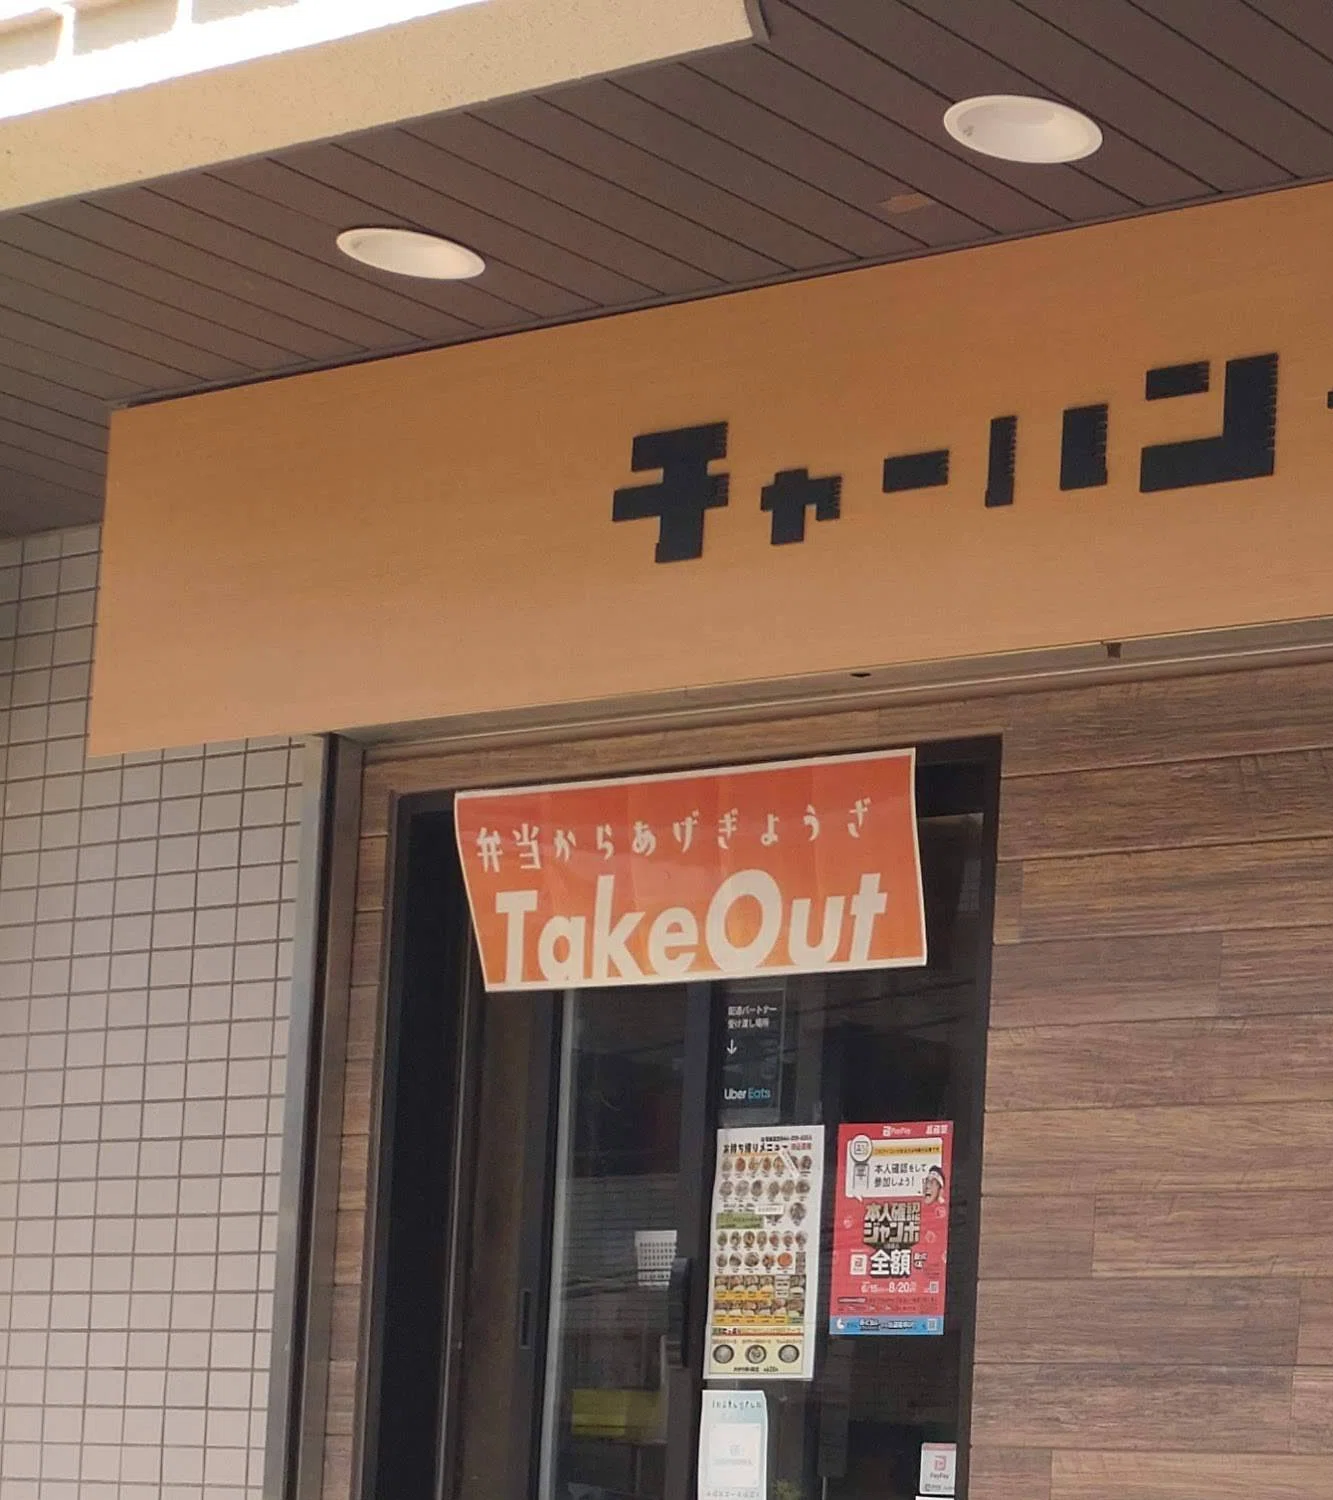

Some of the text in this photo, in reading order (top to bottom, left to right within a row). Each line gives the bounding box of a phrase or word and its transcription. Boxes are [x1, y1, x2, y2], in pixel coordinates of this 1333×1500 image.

[612, 353, 1277, 564] チャーハン
[476, 797, 872, 873] 弁当からあげぎょうざ
[495, 868, 888, 984] TakeOut
[724, 1087, 771, 1100] Uber Eats
[864, 1222, 920, 1244] ジャンボ
[870, 1250, 911, 1277] 全額
